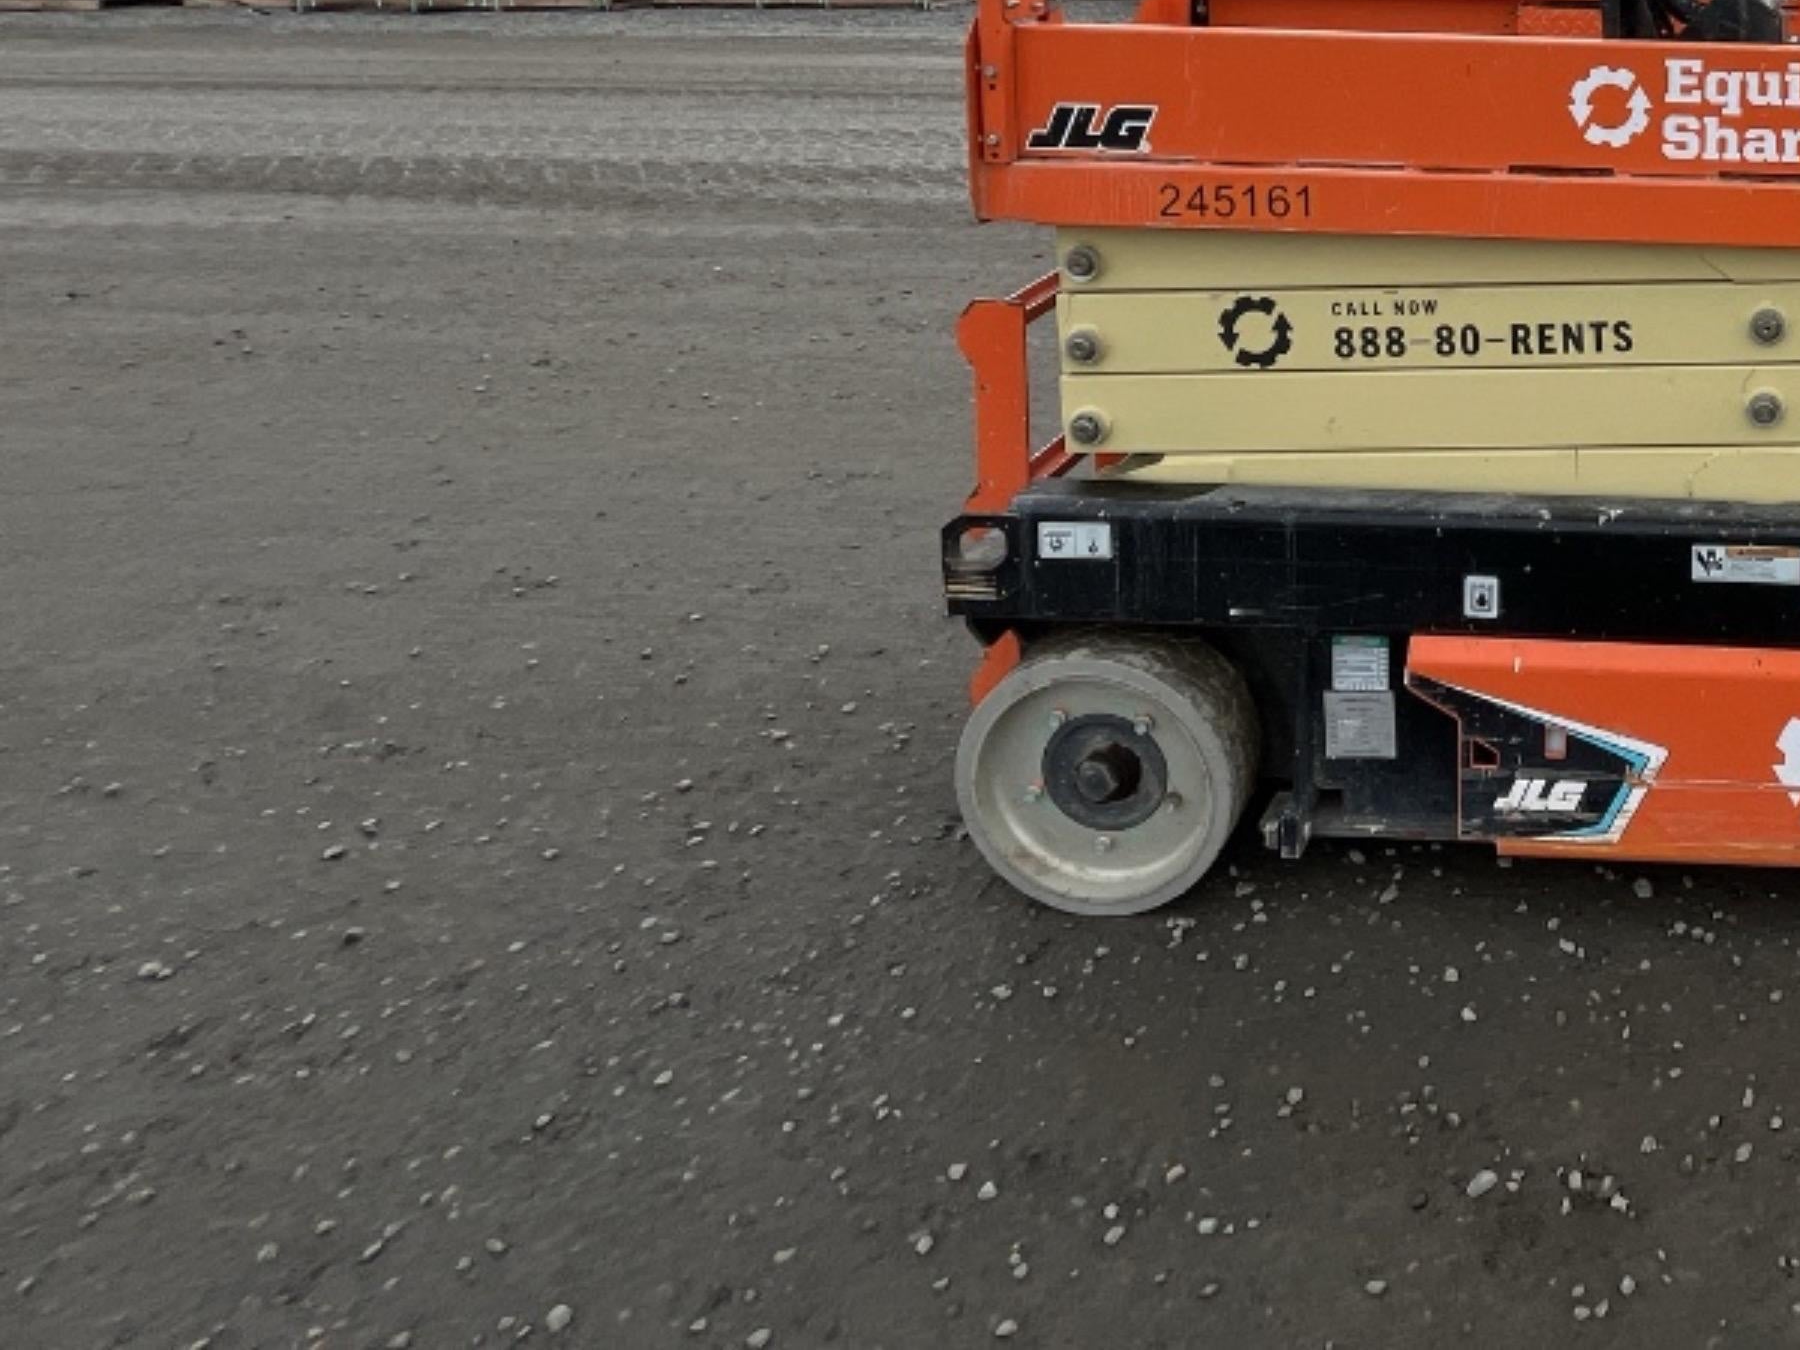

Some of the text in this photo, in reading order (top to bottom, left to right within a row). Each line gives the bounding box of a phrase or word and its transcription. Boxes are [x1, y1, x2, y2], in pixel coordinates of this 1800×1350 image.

[1025, 102, 1158, 153] JLG
[1159, 183, 1313, 218] 245161
[1331, 299, 1439, 317] CALL NOW
[1334, 321, 1634, 360] 888-80-RENTS
[1493, 779, 1588, 811] JLG
